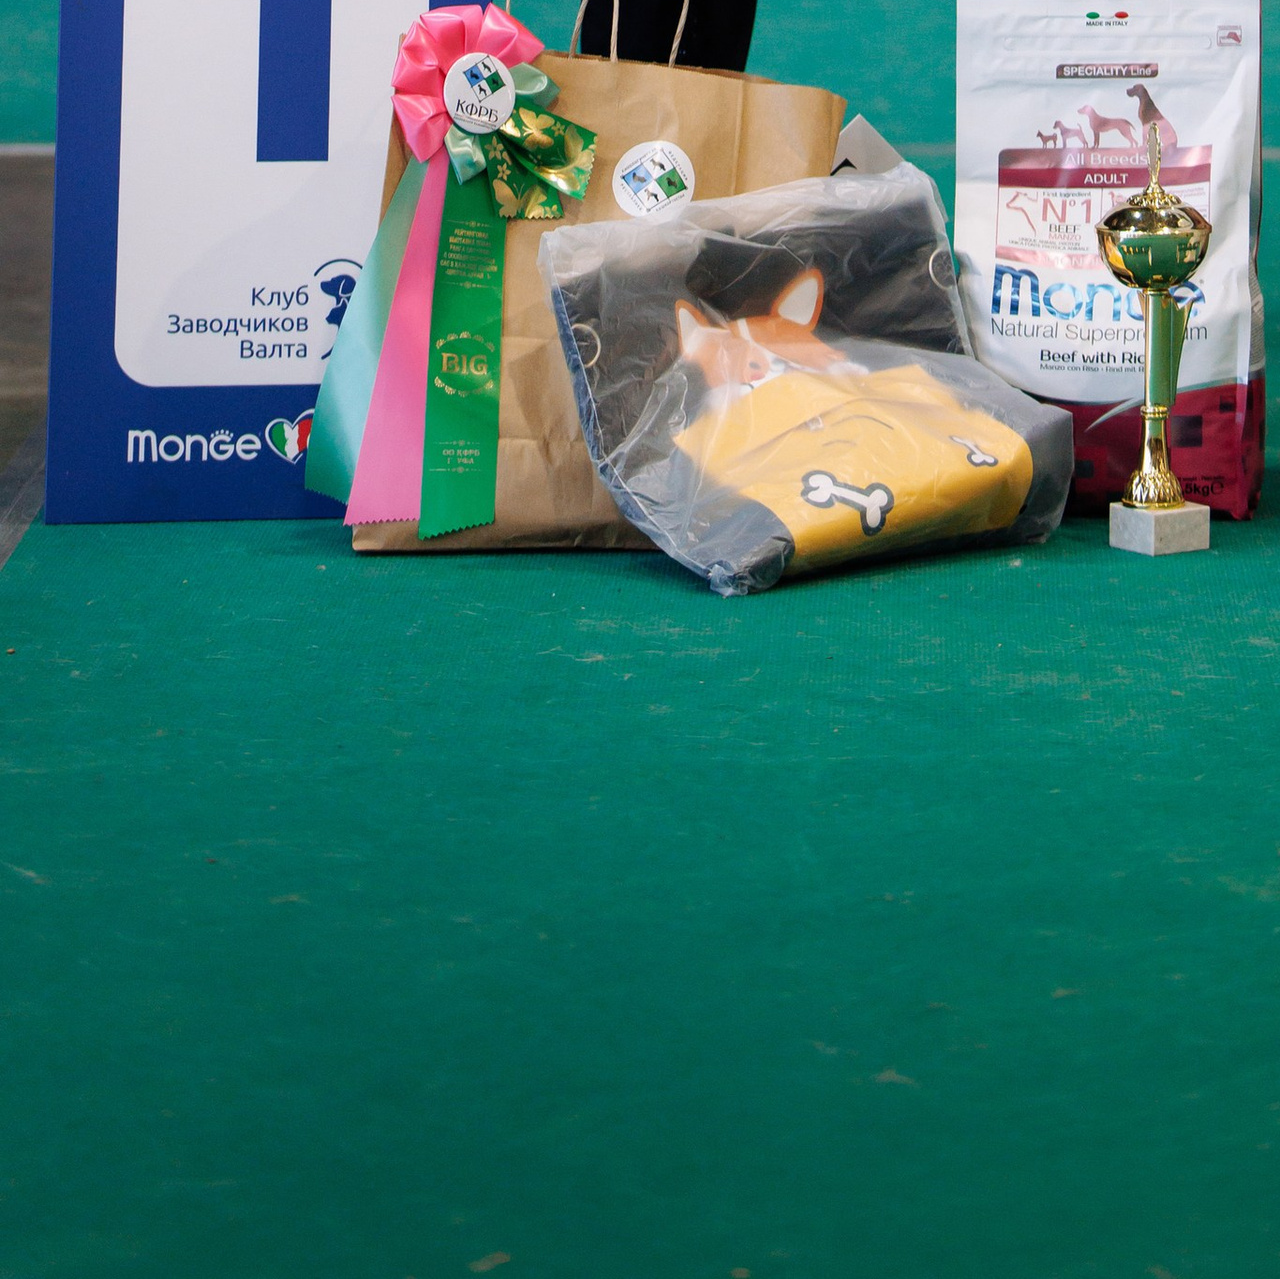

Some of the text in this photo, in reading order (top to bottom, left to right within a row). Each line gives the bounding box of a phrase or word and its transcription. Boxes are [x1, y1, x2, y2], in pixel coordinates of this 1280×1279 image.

[1063, 66, 1152, 76] SPECIALITY Line
[455, 98, 499, 123] КФРБ
[1065, 152, 1149, 166] All Breeds
[1083, 173, 1129, 184] ADULT
[1049, 223, 1081, 234] BEEF
[250, 285, 310, 311] Клуб
[166, 314, 310, 337] Заводчиков
[990, 317, 1059, 339] Natural
[239, 339, 309, 359] Валта
[1040, 349, 1078, 363] Beef
[1082, 351, 1117, 364] with
[441, 352, 488, 376] BIG
